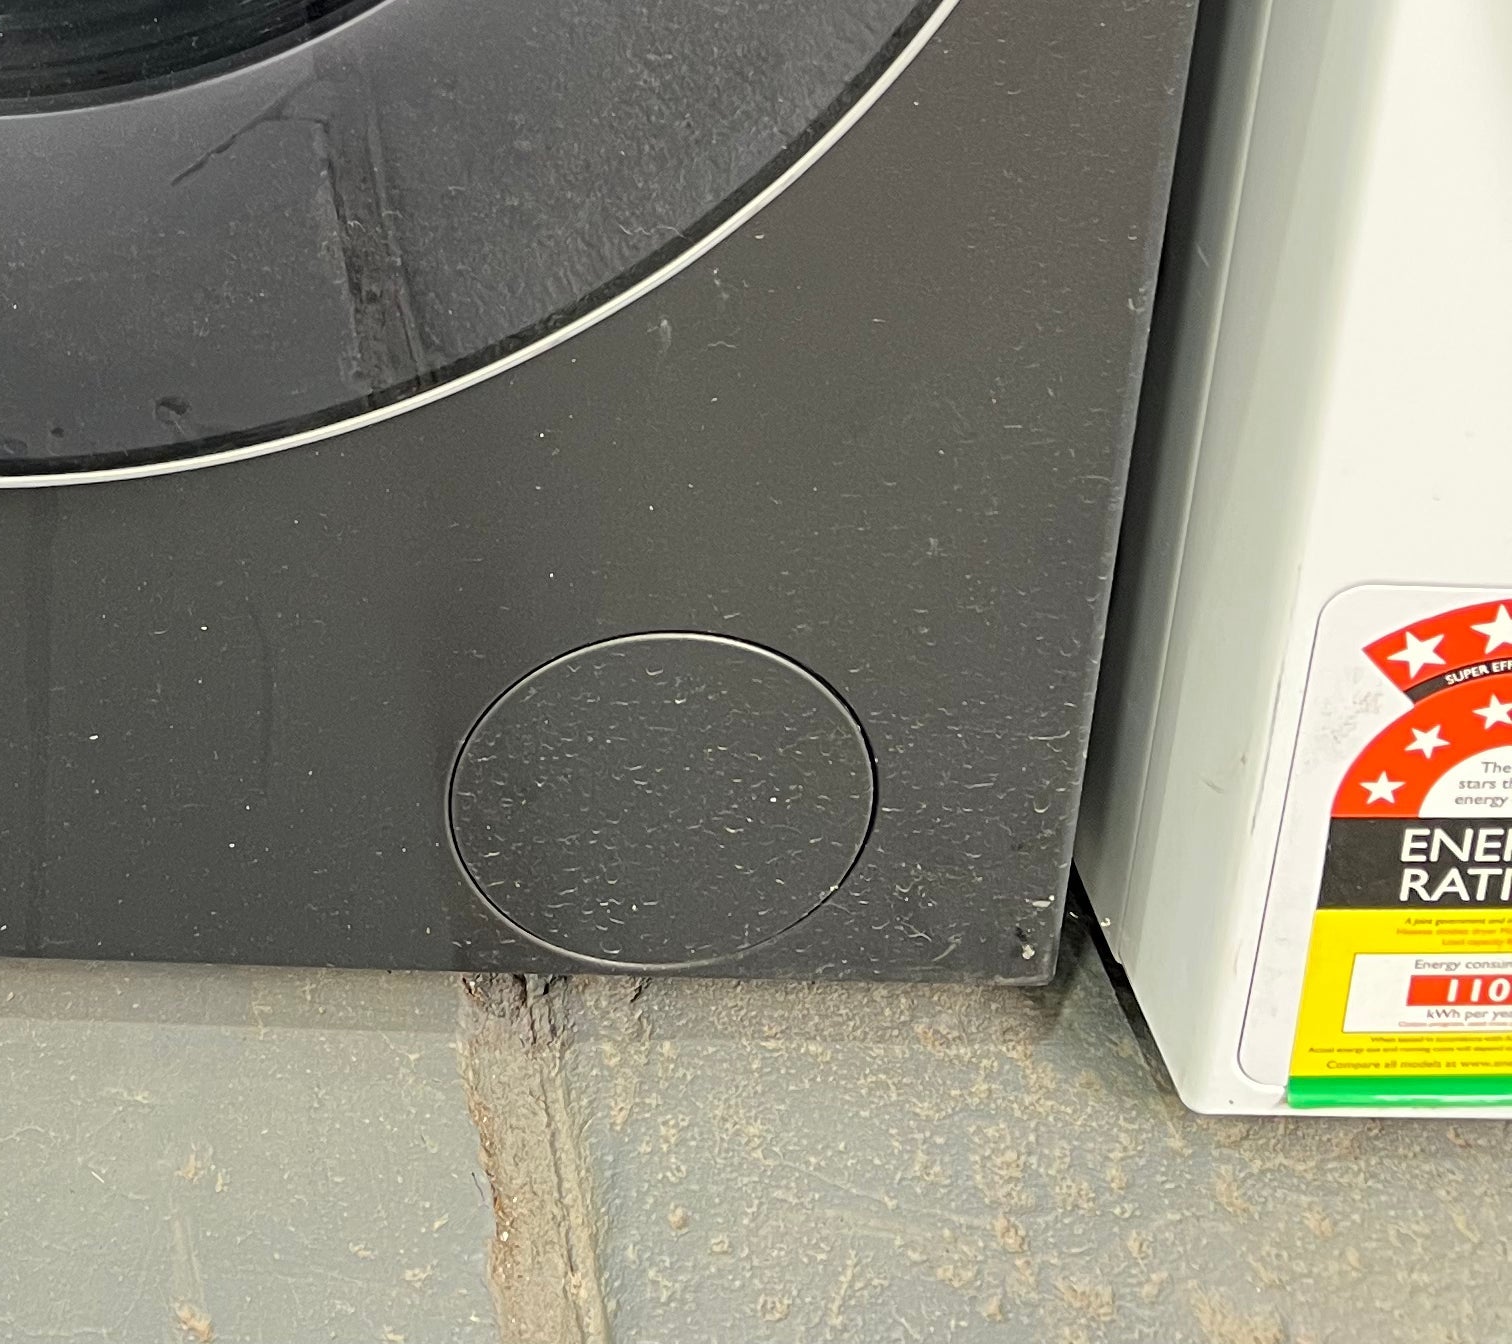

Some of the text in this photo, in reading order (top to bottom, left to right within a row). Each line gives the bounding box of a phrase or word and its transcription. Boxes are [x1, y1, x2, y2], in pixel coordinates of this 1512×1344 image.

[1445, 664, 1489, 685] SUPER
[1481, 761, 1512, 773] The
[1459, 780, 1497, 789] stars
[1454, 796, 1509, 808] energy
[1415, 959, 1461, 971] Energy
[1447, 978, 1511, 1002] 110
[1427, 1009, 1461, 1019] kWh
[1464, 1011, 1489, 1021] per
[1326, 1060, 1380, 1071] Compare
